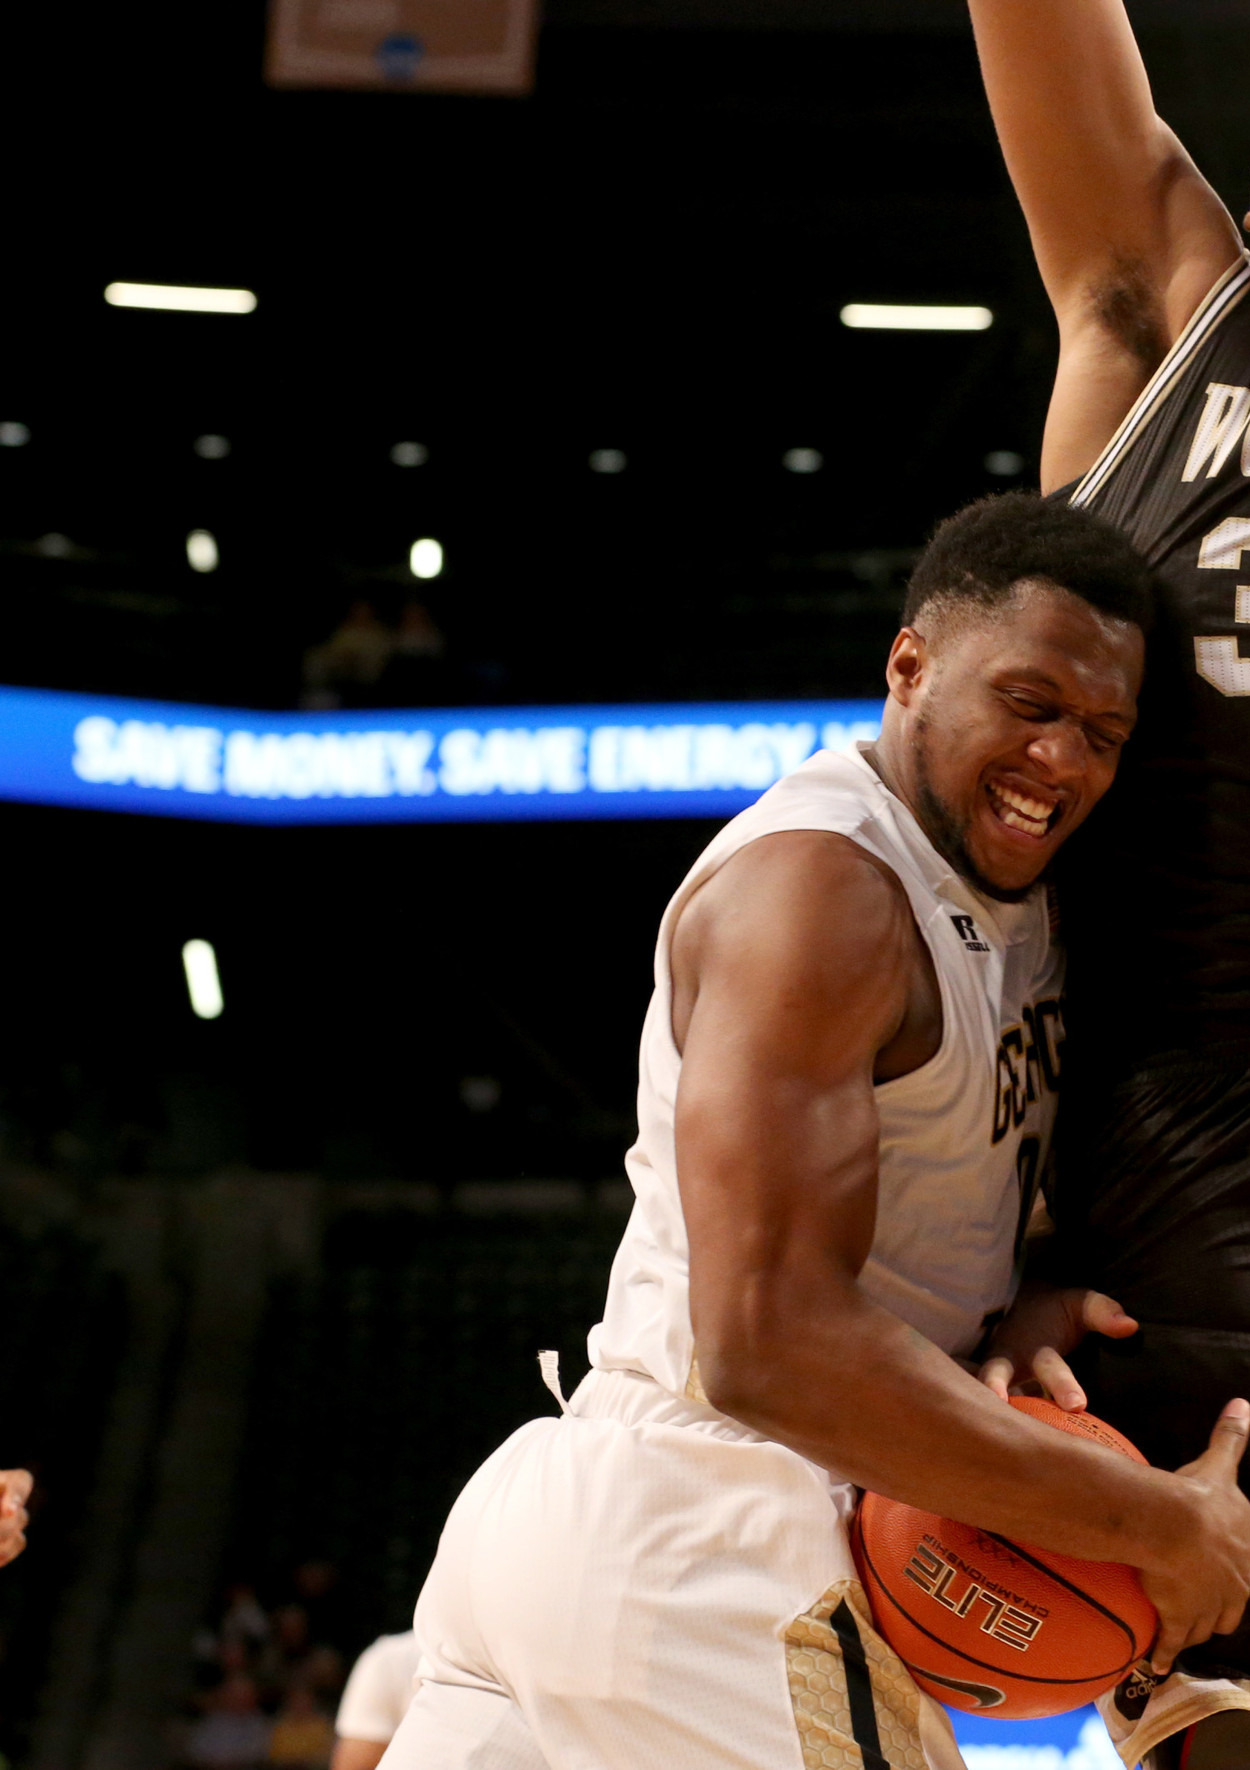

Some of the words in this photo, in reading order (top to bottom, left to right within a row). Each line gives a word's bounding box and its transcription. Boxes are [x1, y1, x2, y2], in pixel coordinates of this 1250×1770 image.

[73, 716, 221, 794] SAVE
[438, 728, 586, 796] SAVE
[903, 1541, 1044, 1652] ELITE
[921, 1533, 1050, 1619] CHAMPIONSHIP
